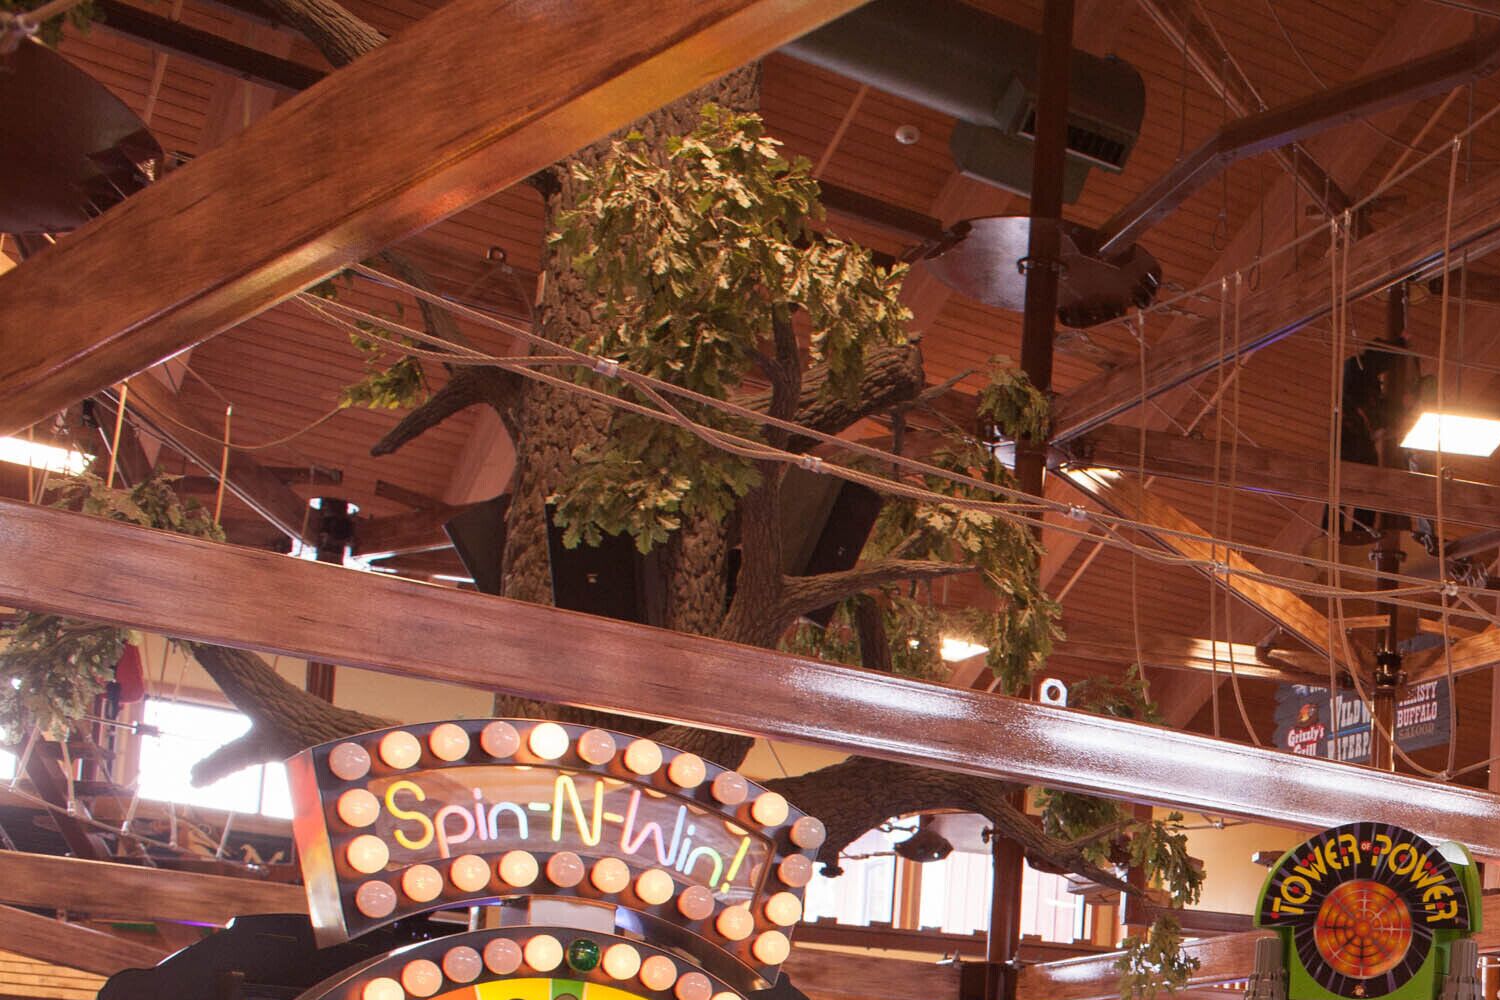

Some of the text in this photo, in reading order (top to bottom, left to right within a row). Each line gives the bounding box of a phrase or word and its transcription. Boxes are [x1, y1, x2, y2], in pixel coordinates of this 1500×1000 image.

[1288, 724, 1325, 747] Grizzly's
[1396, 701, 1438, 728] BUFFALO
[385, 774, 751, 893] Spin-N-Win!
[1271, 833, 1459, 923] TOWER OF POWER
